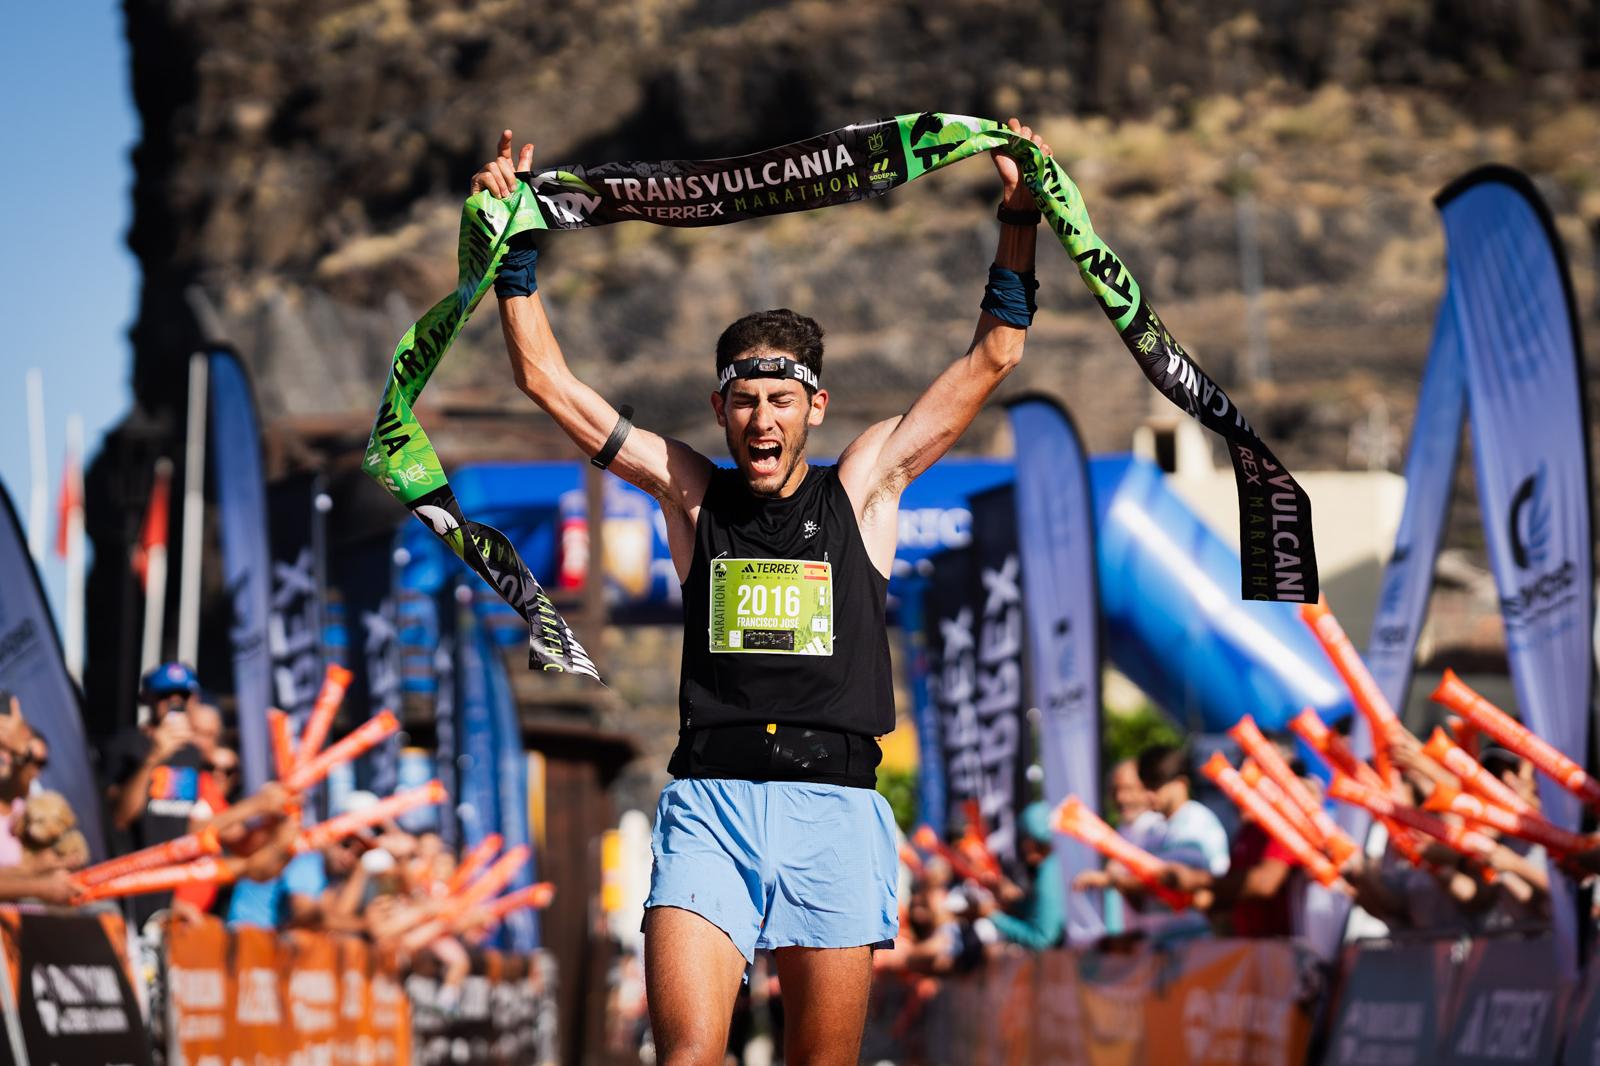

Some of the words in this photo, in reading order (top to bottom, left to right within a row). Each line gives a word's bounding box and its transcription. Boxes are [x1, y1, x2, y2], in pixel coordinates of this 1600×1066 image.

[604, 144, 854, 201] TRANSVULCANIA
[869, 171, 898, 182] SODEPAL
[644, 201, 724, 219] TERREX
[734, 172, 859, 211] MARATHON
[757, 562, 800, 574] TERREX
[714, 585, 726, 641] MARATHON
[737, 584, 800, 617] 2016
[737, 617, 778, 628] FRANCISCO
[779, 617, 800, 629] JOSÉ
